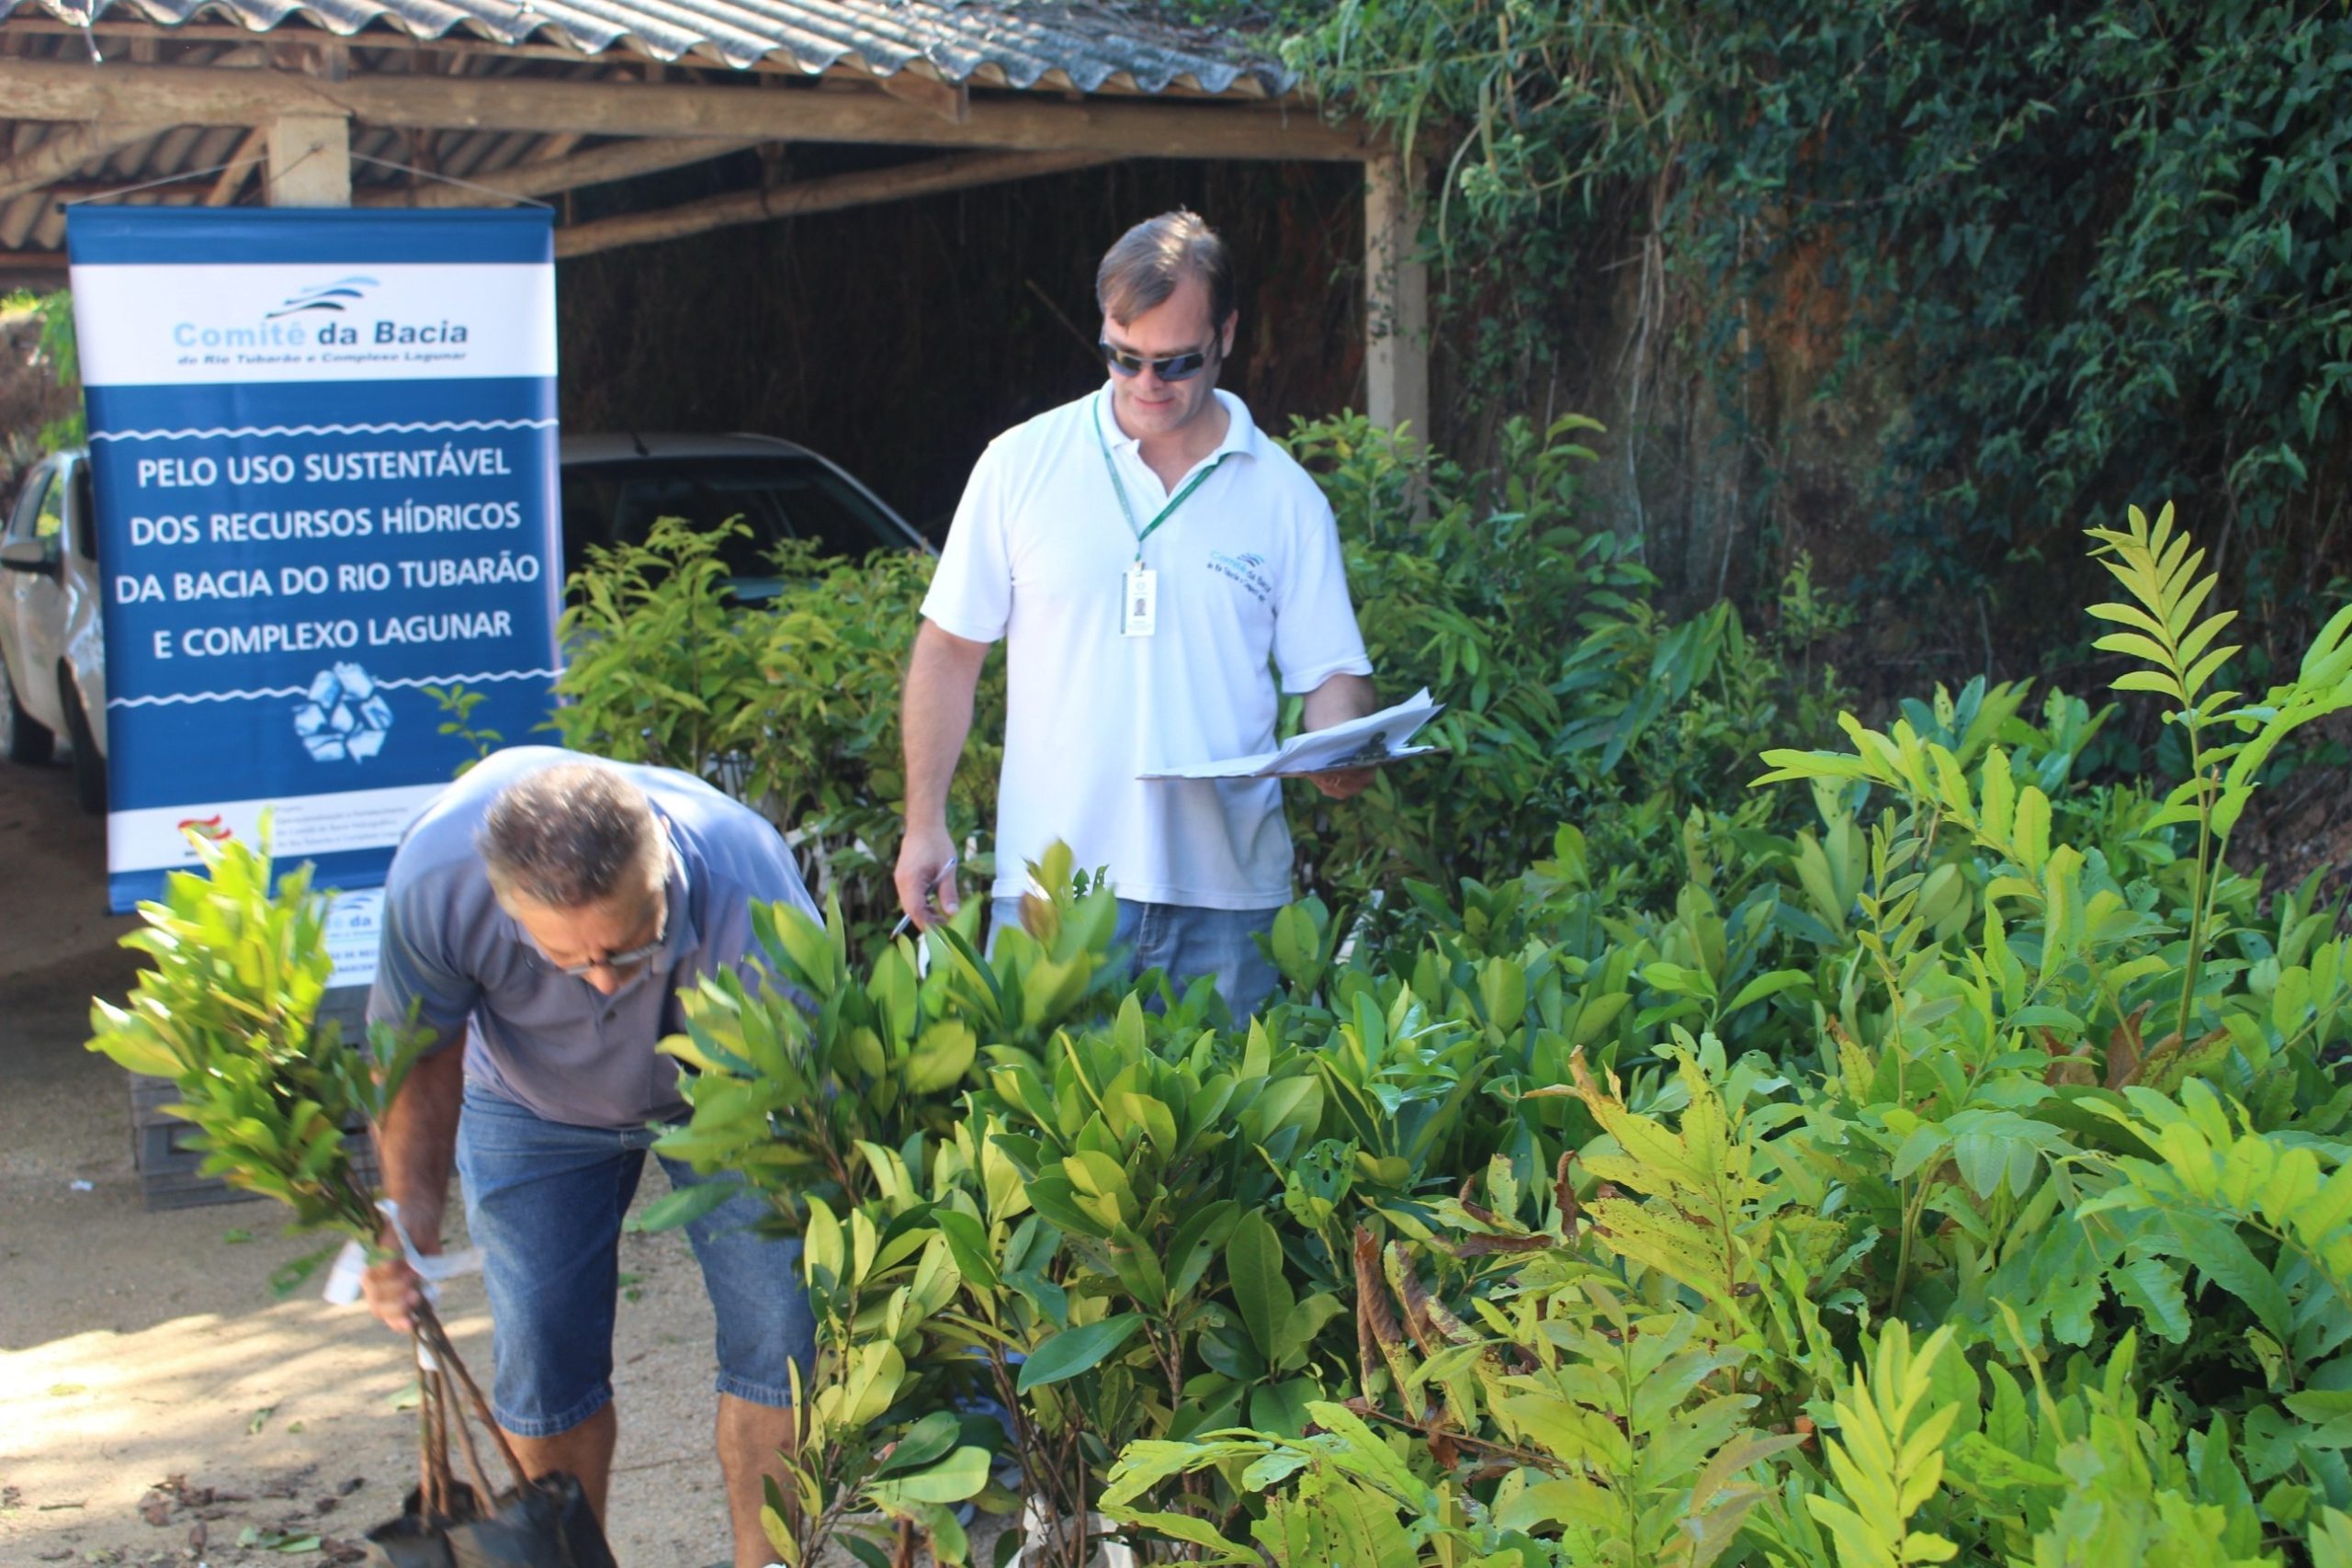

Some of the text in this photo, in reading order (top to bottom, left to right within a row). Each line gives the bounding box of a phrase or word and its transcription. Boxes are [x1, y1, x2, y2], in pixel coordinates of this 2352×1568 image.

[173, 319, 469, 347] Comitê da Bacia
[203, 355, 231, 365] Rio
[236, 353, 301, 365] Tubarão
[306, 355, 316, 364] e
[321, 352, 400, 365] Complexo
[403, 350, 467, 364] Lagunar
[137, 443, 510, 488] PELO USO SUSTENTÁVEL
[130, 499, 521, 546] DOS RECURSOS HÍDRICOS
[116, 550, 539, 604] DA BACIA DO RIO TUBARÃO
[153, 610, 512, 659] E COMPLEXO LAGUNAR
